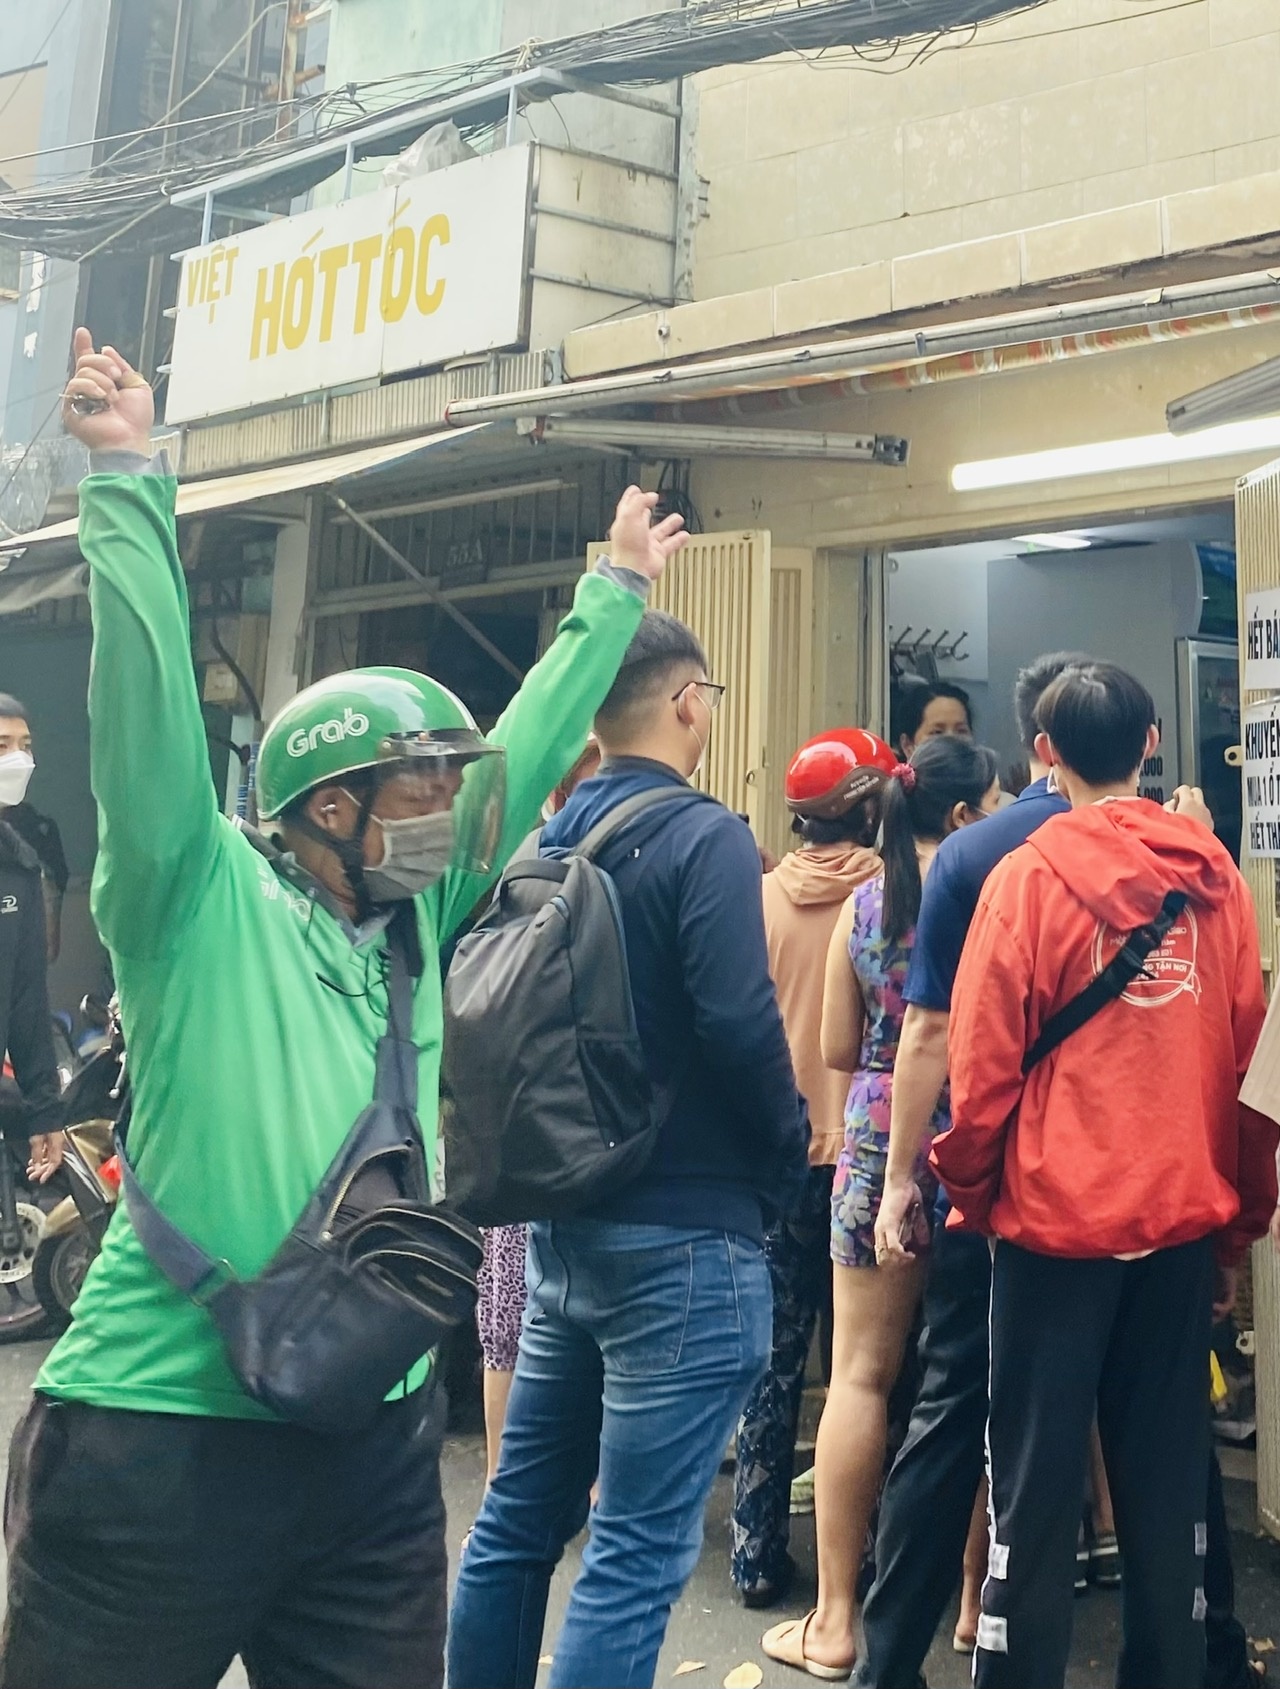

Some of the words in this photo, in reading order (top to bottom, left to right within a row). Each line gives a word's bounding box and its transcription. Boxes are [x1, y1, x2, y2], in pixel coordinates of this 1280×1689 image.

[187, 245, 240, 324] VIỆT
[1247, 605, 1264, 660] HẾT
[287, 708, 370, 758] Grab
[1263, 776, 1267, 806] 1
[1250, 811, 1264, 850] HẾT
